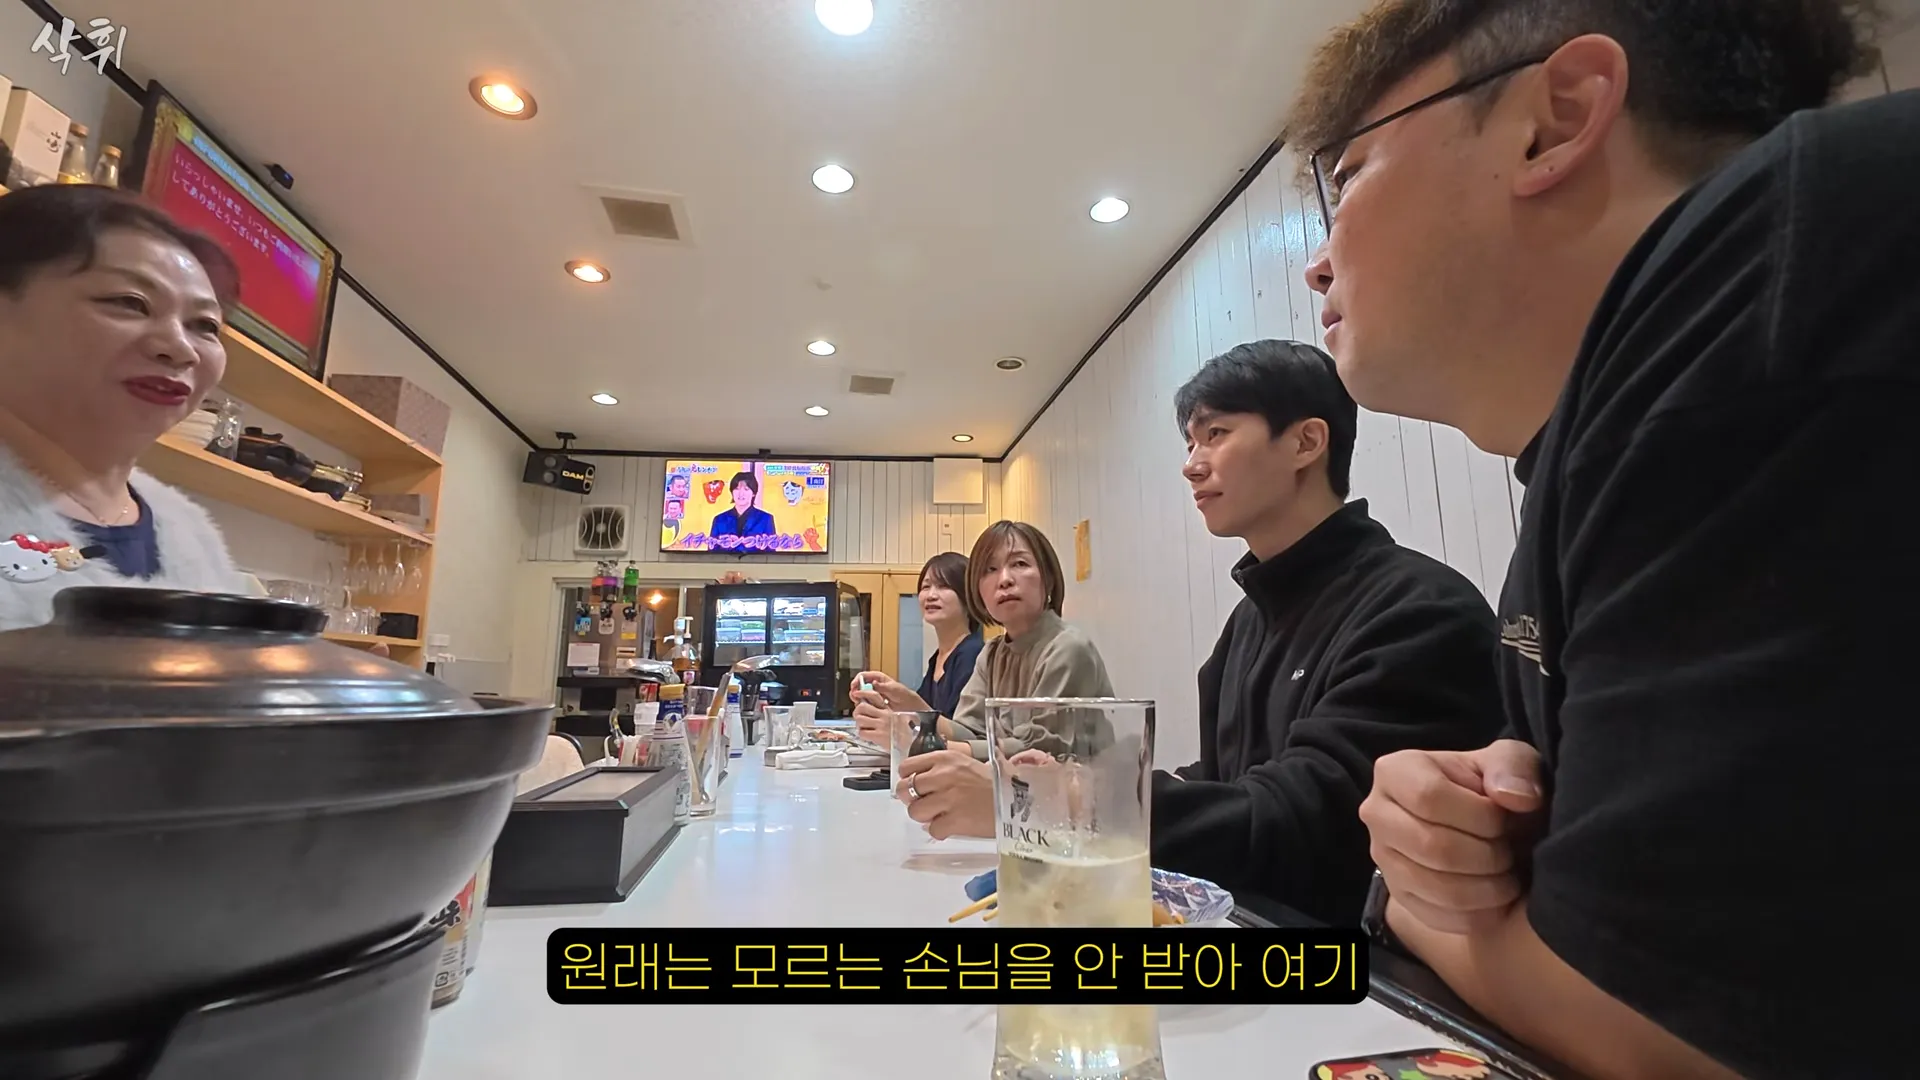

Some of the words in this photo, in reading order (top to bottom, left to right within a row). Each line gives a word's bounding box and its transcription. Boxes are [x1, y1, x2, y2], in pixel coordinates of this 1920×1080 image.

[562, 470, 584, 481] DAM
[680, 532, 804, 550] イチャモンつけるなら
[1003, 822, 1050, 847] BLACK
